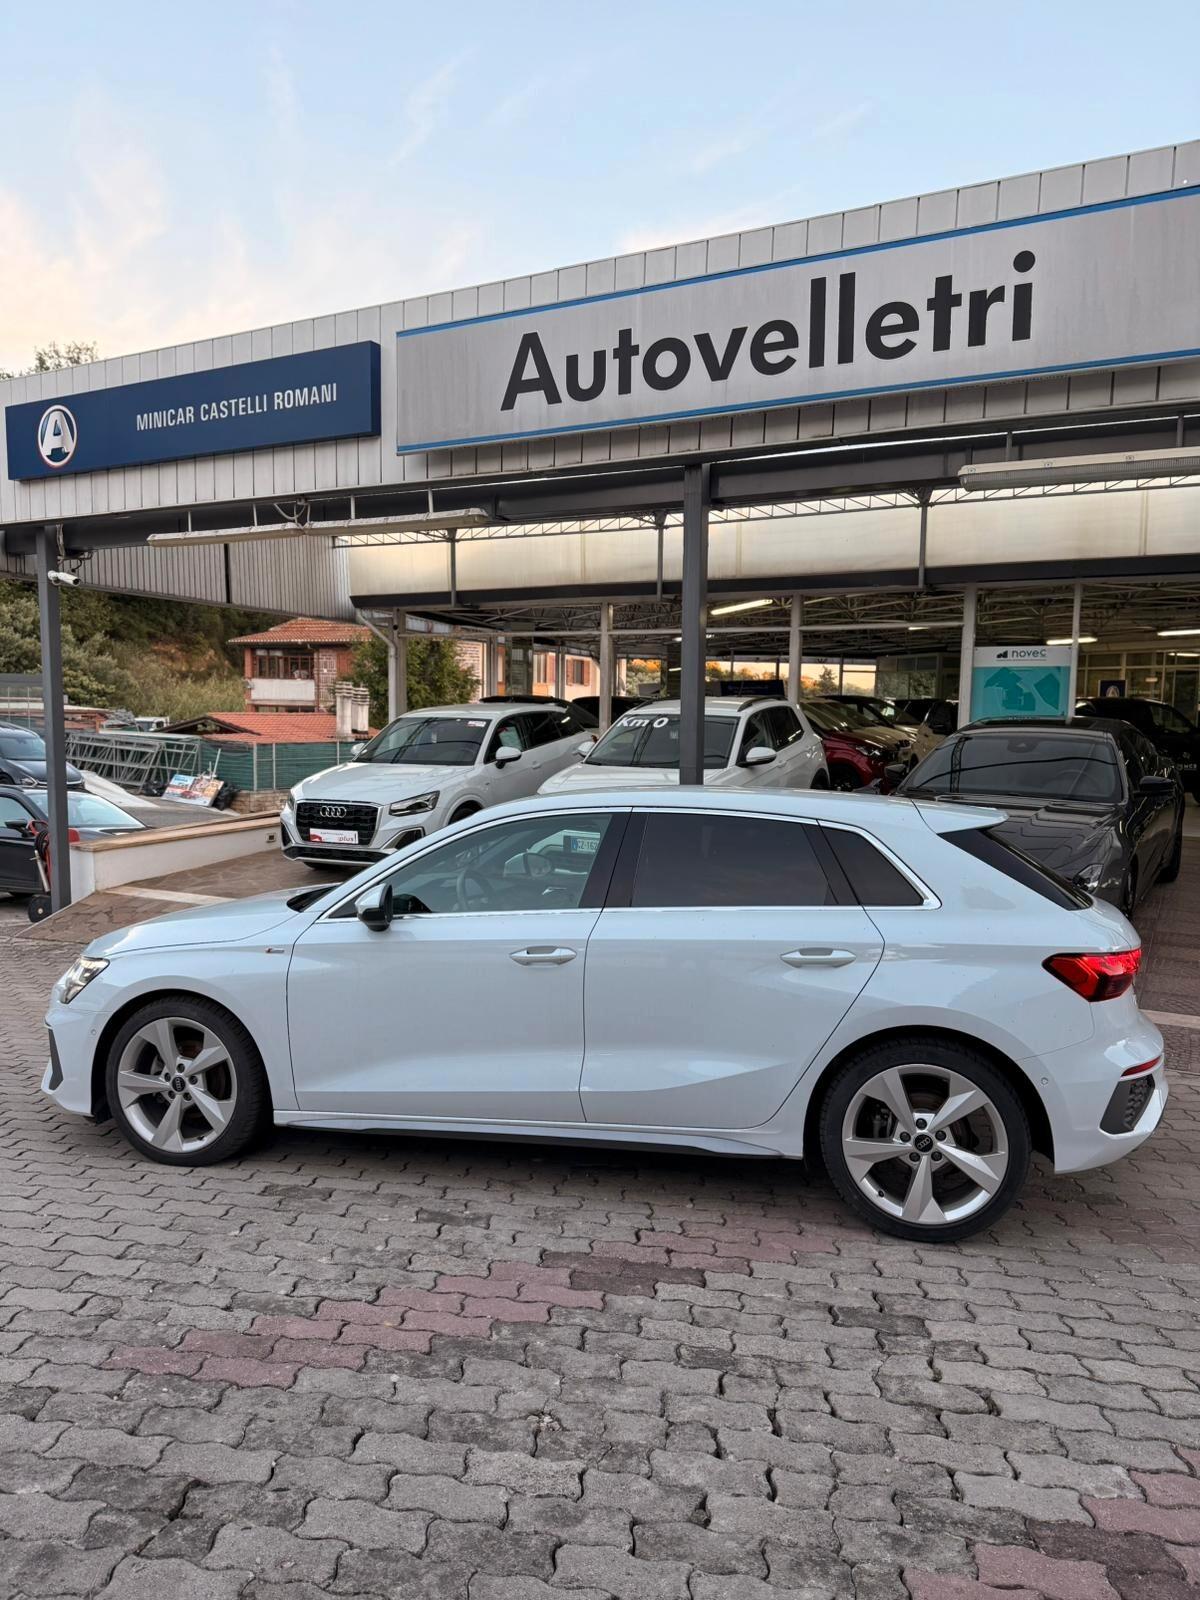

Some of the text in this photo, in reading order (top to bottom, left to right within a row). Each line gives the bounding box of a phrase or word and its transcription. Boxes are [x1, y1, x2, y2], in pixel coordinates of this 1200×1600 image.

[500, 249, 1036, 412] Autovelletri
[136, 382, 338, 432] MINICAR CASTELLI ROMANI
[616, 716, 650, 727] Km
